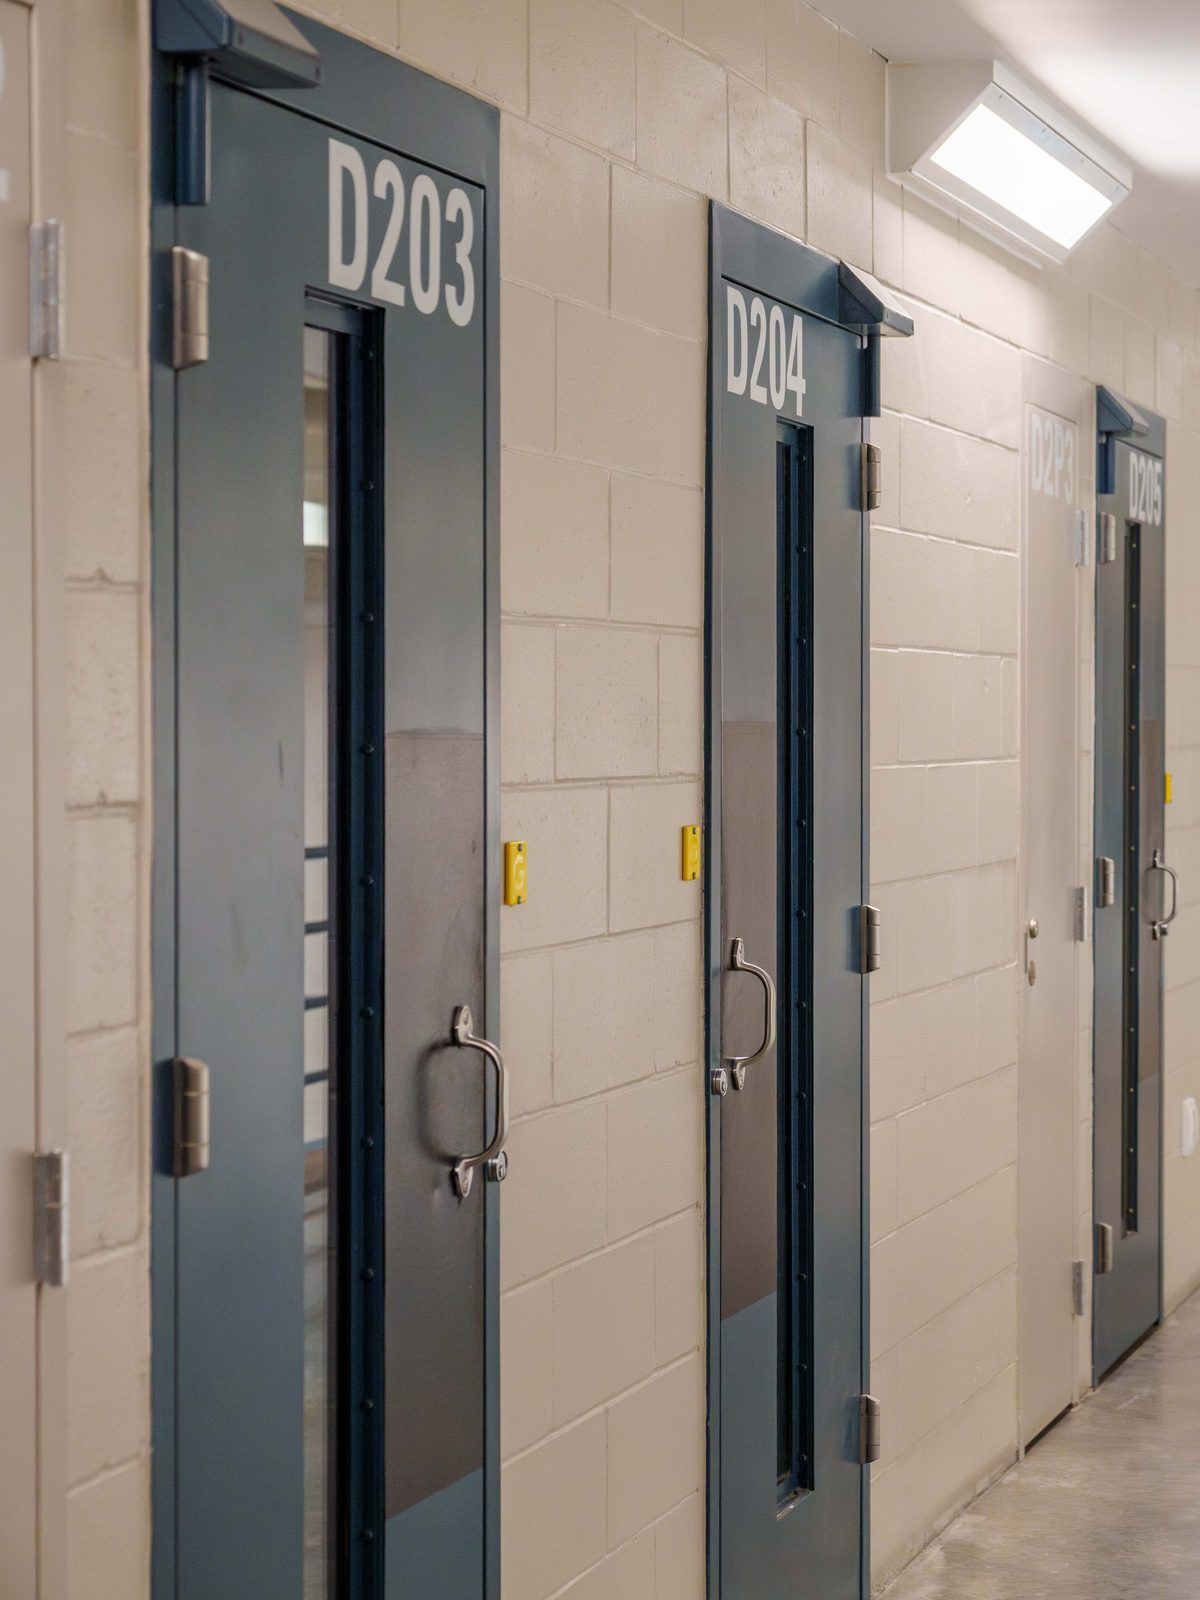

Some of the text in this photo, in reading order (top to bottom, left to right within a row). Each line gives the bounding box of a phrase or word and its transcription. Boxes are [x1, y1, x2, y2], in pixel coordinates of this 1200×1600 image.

[329, 138, 475, 327] D203
[727, 285, 806, 417] D204
[1032, 413, 1073, 505] D2P3
[1129, 451, 1163, 526] D205
